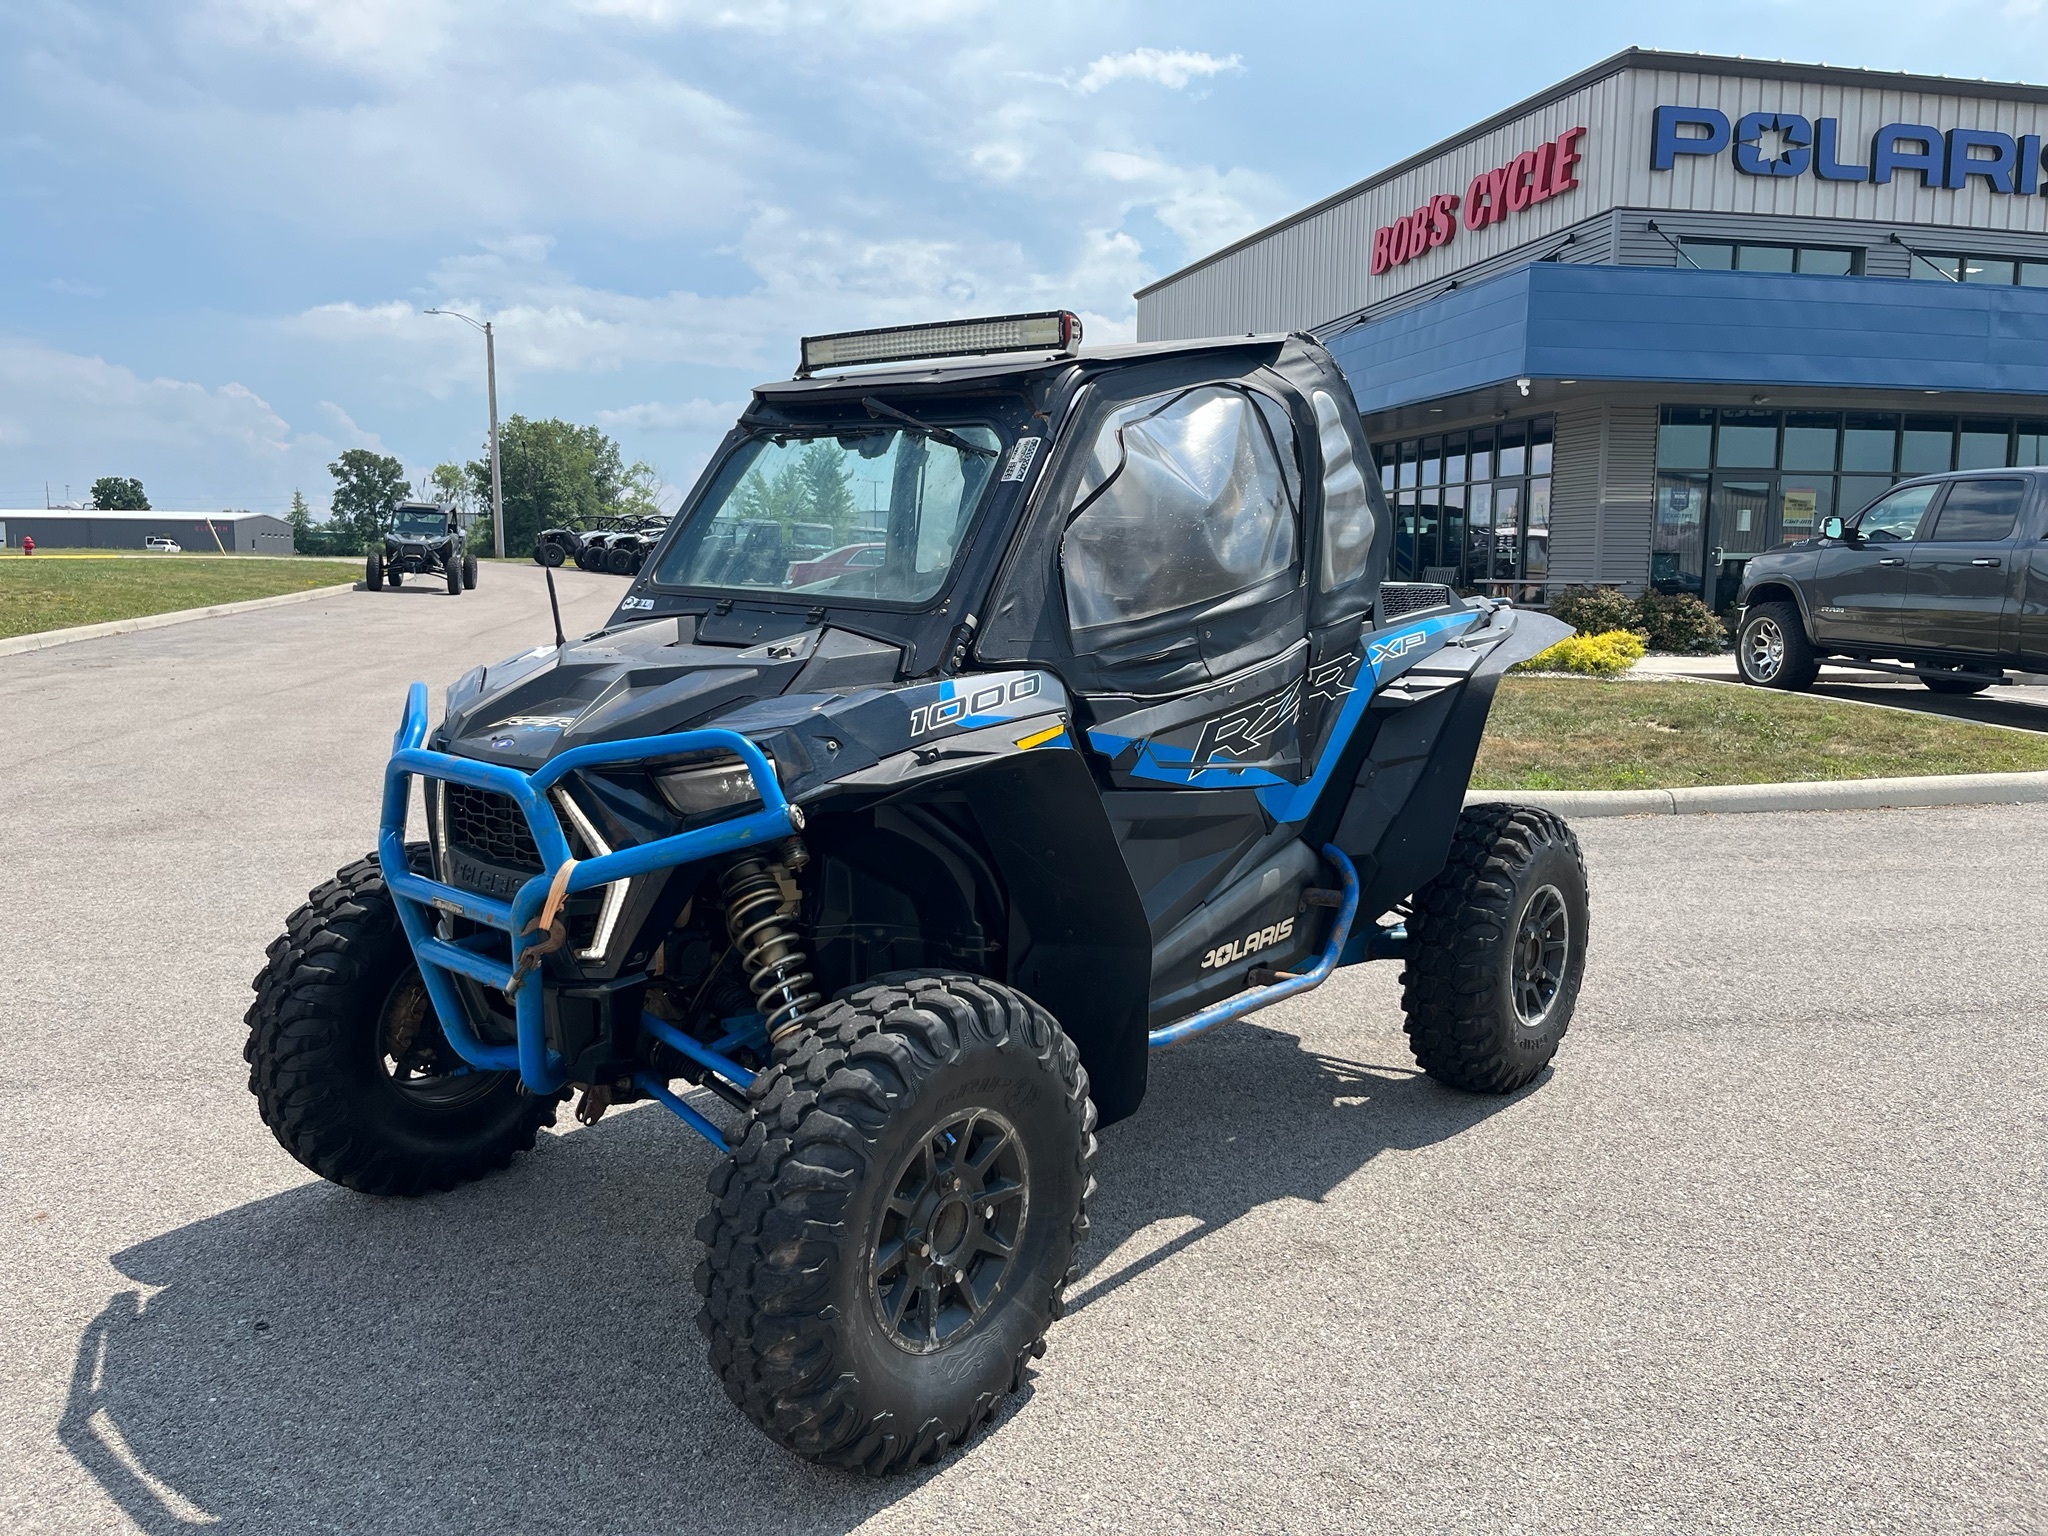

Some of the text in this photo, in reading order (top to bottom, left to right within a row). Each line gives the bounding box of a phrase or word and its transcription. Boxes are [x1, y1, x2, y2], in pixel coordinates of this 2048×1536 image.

[1650, 105, 2048, 198] POLARI
[1371, 127, 1587, 276] BOB'S CYCLE
[1366, 631, 1427, 668] XP
[910, 672, 1042, 738] 1000
